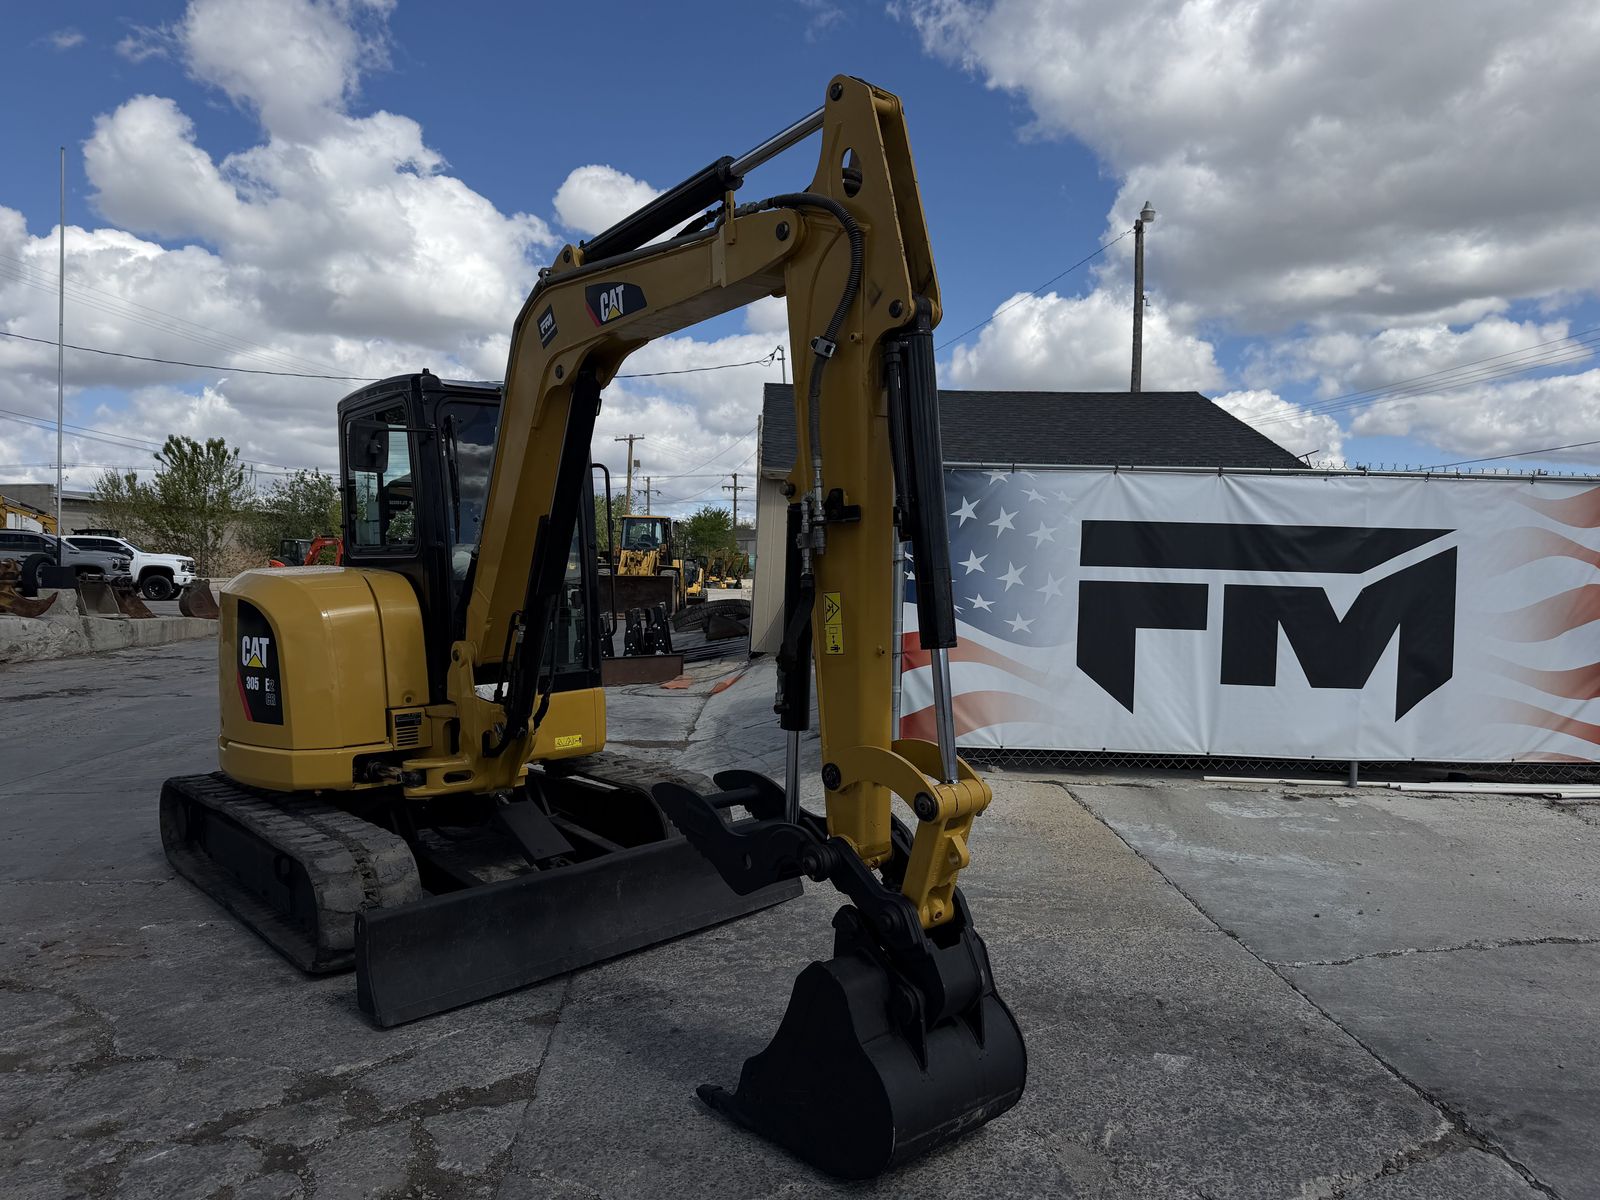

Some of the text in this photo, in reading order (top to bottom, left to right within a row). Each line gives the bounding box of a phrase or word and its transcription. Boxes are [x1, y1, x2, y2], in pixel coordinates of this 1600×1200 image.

[600, 284, 625, 322] CAT
[241, 635, 270, 668] CAT
[246, 676, 259, 690] 305
